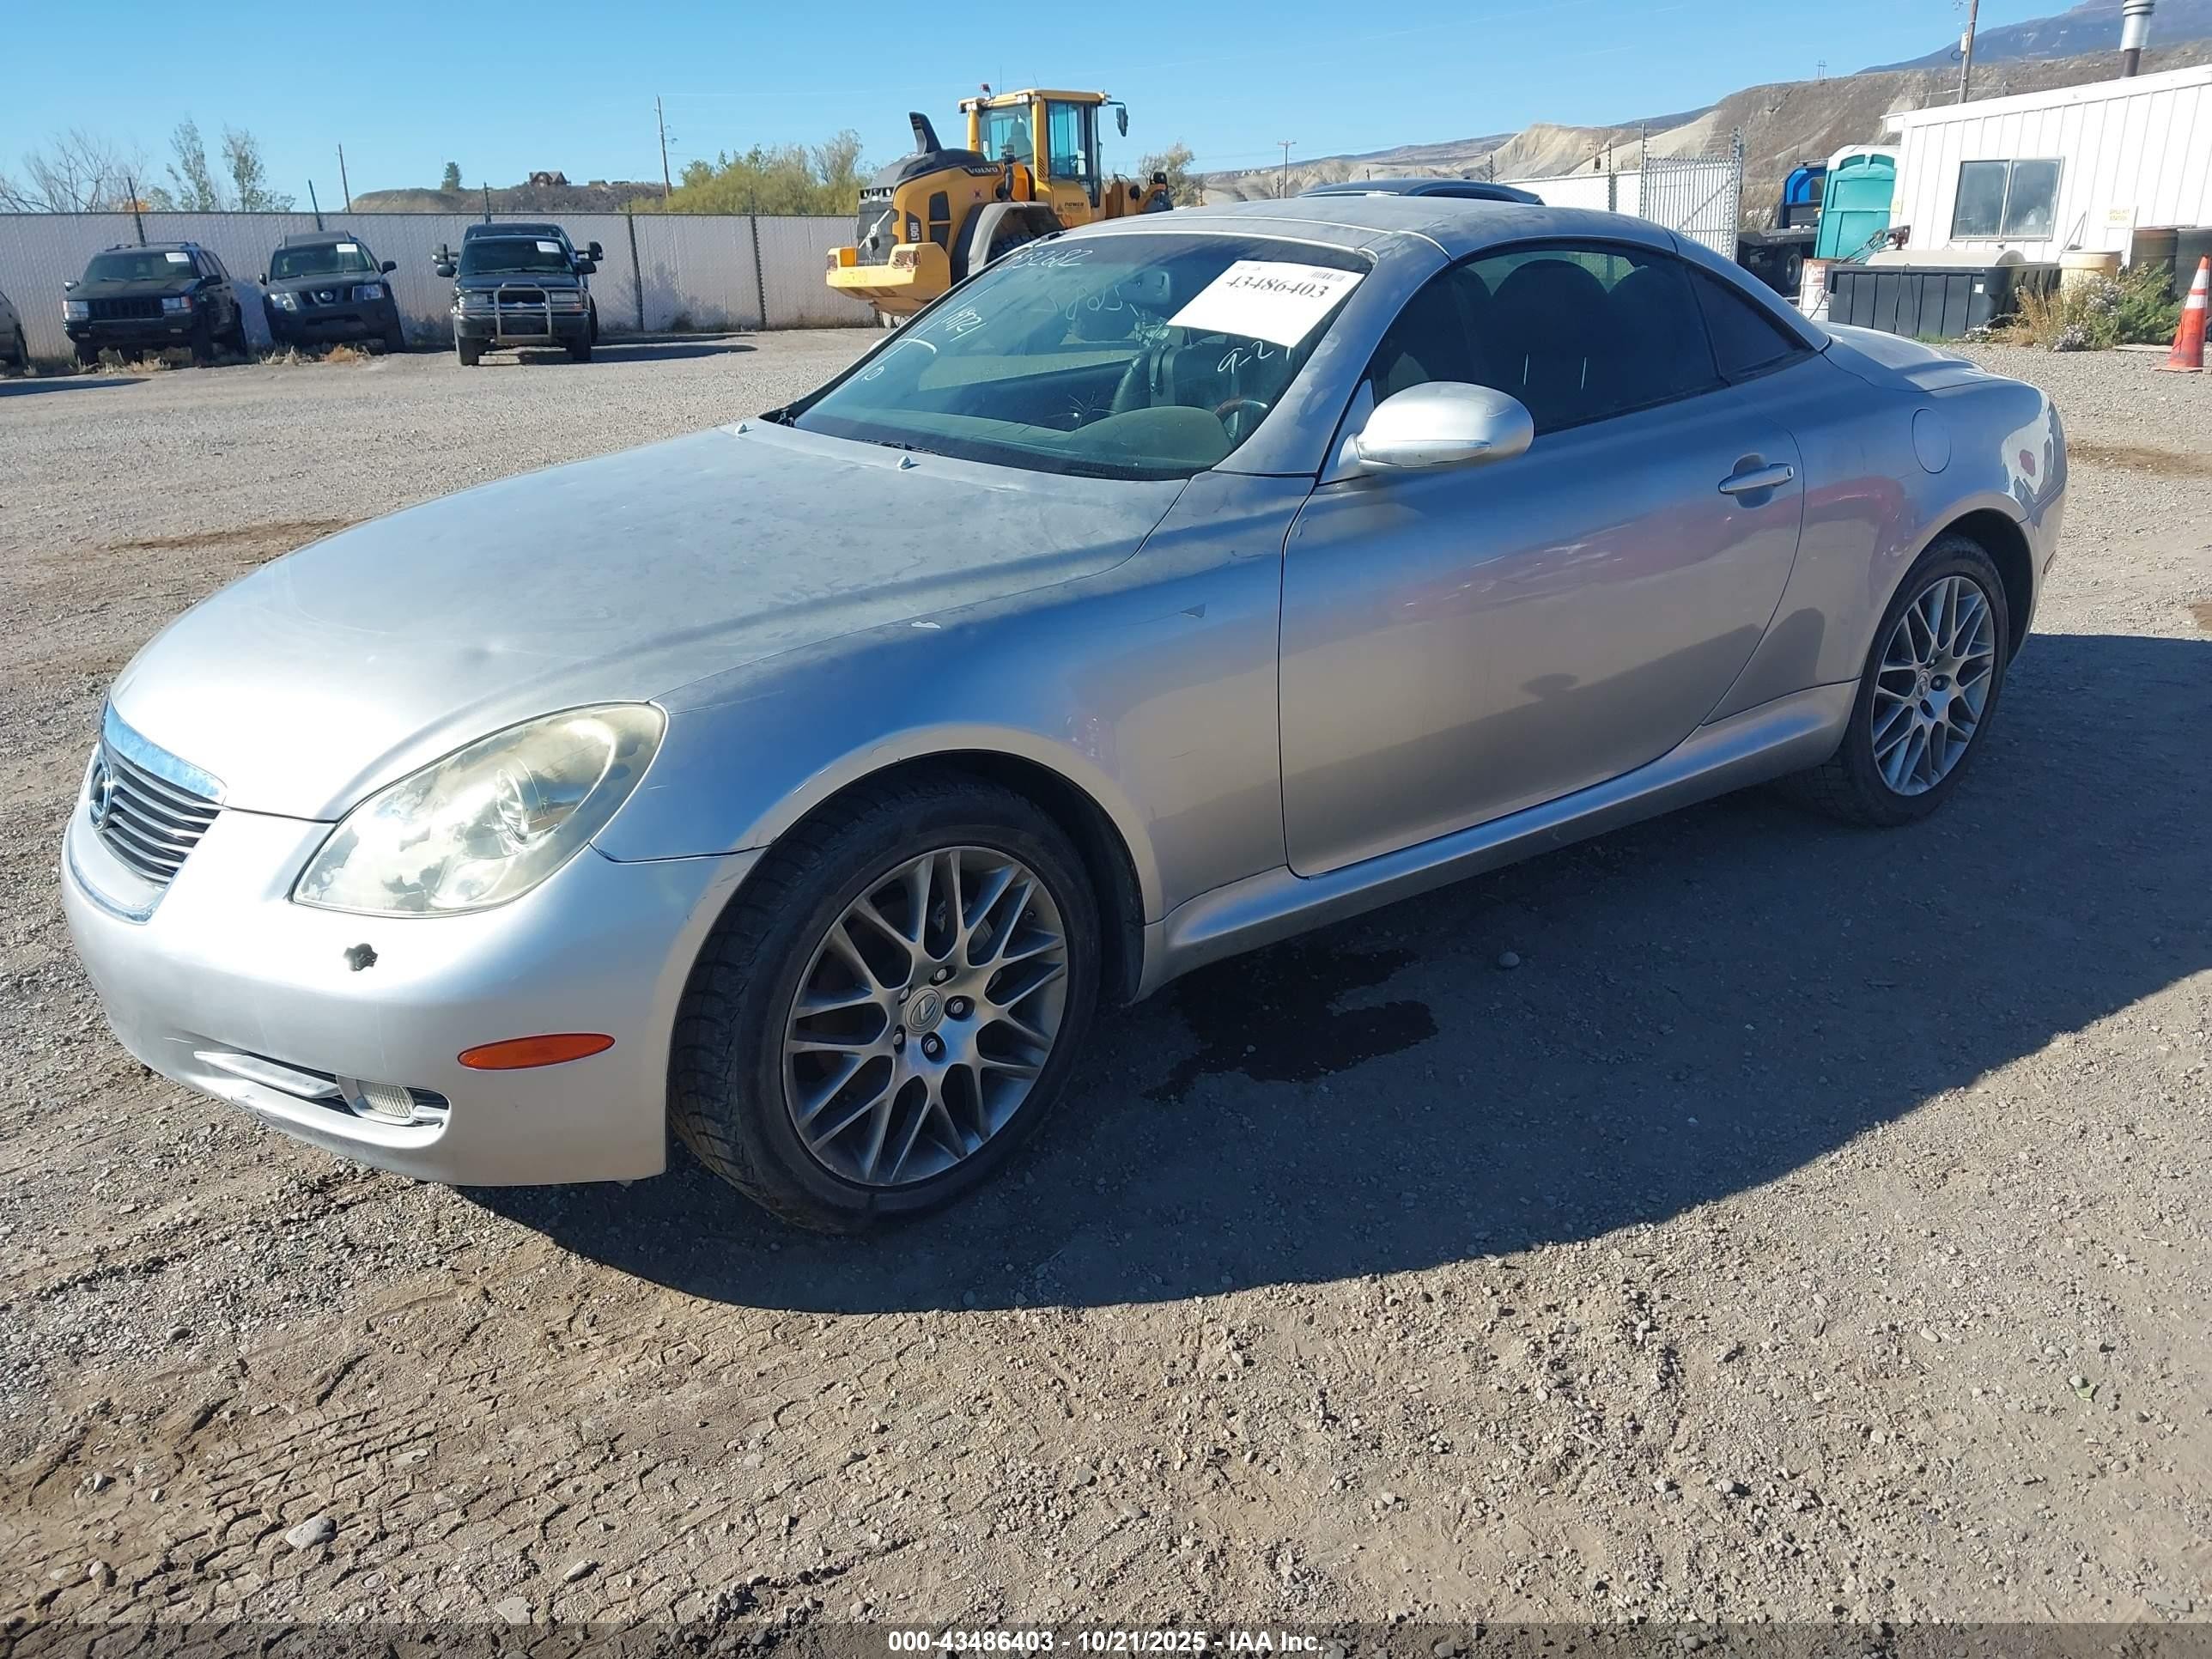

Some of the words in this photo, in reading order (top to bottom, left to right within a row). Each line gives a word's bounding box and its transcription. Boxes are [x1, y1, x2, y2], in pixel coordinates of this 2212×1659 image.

[968, 166, 999, 175] VOLVO
[910, 222, 920, 241] L90H
[1227, 275, 1329, 298] 43486403
